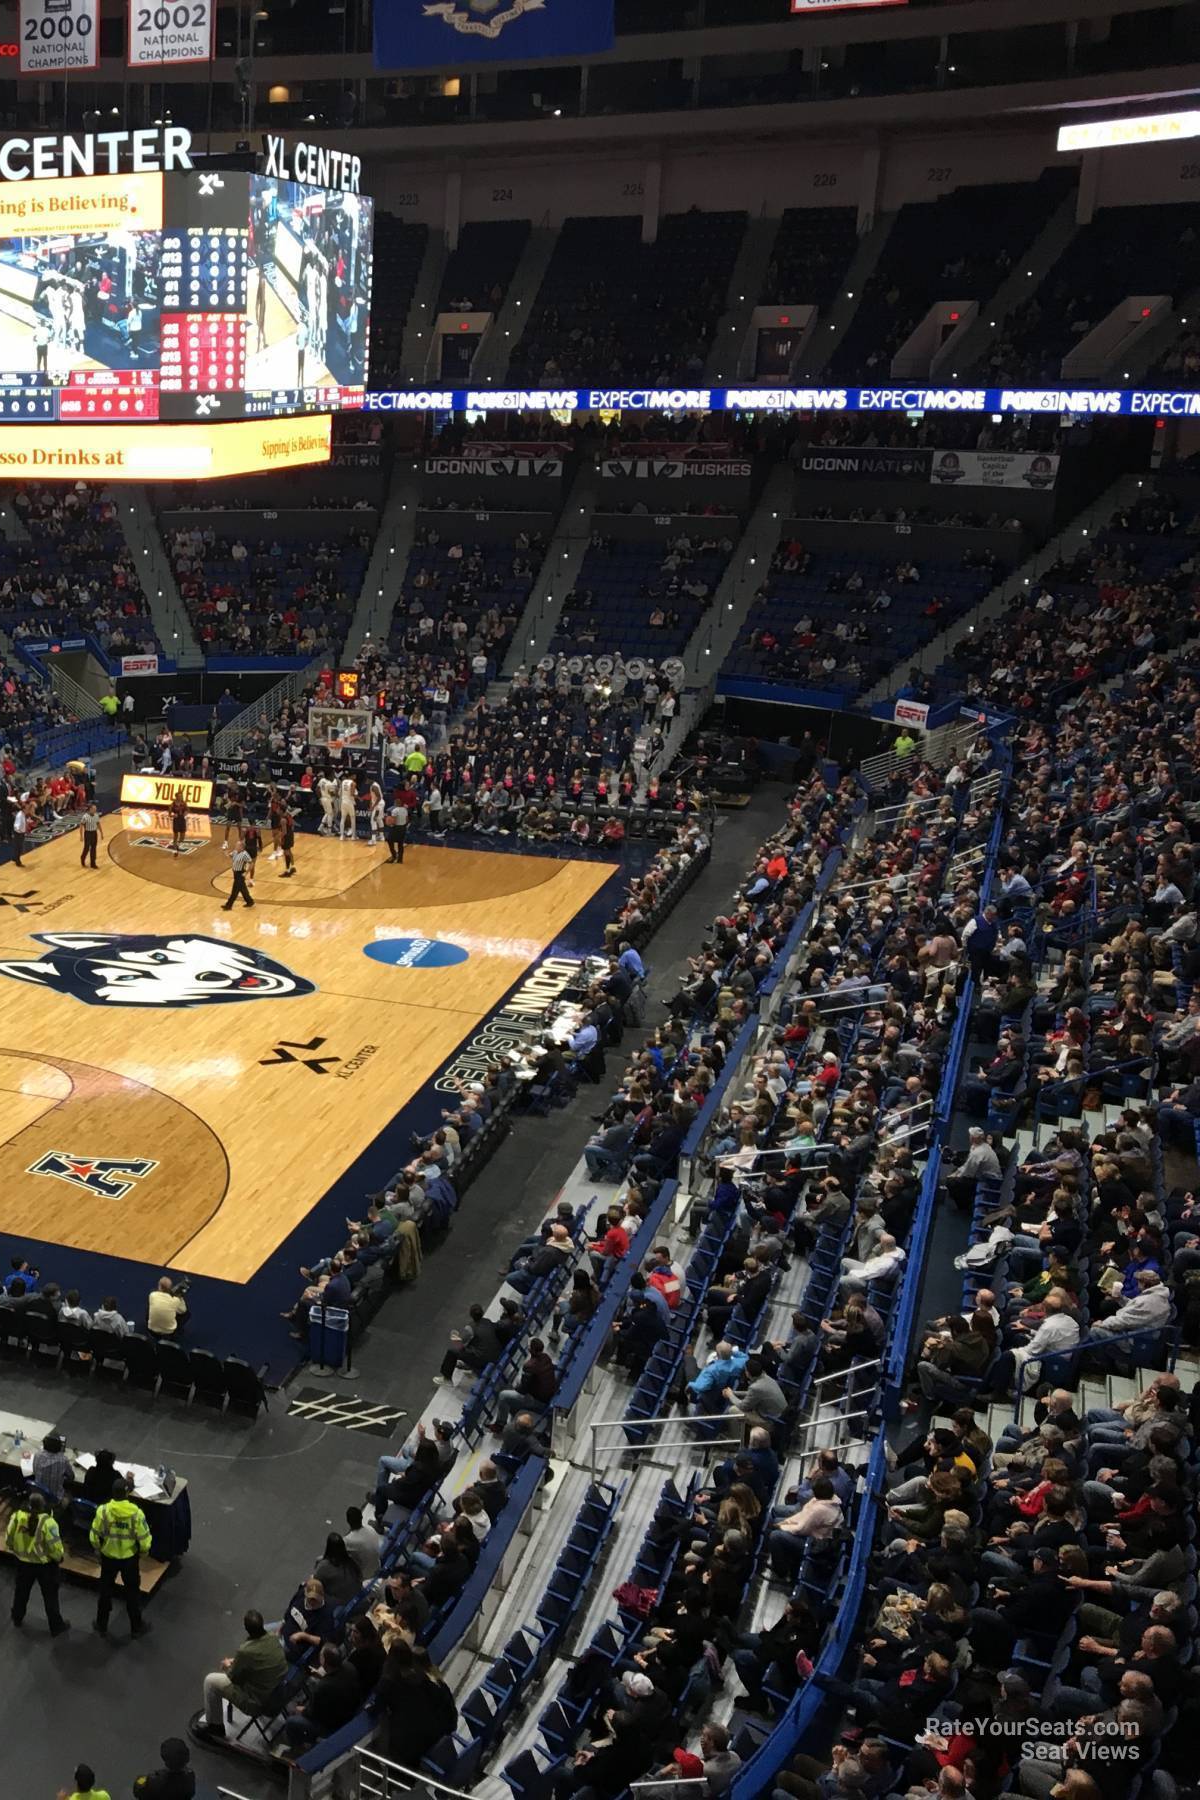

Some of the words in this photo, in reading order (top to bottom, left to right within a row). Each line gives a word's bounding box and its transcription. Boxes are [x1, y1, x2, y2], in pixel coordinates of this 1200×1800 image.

[137, 4, 206, 32] 2002
[24, 14, 92, 41] 2000
[32, 41, 85, 55] NATIONAL
[143, 33, 200, 46] NATIONAL
[27, 55, 89, 69] CHAMPIONS
[138, 46, 204, 61] CHAMPIONS
[265, 134, 290, 180] XL
[294, 141, 362, 194] CENTER
[31, 200, 45, 214] is
[48, 193, 129, 214] Believing
[492, 188, 513, 202] 224
[262, 436, 290, 459] Sipping
[298, 433, 330, 453] Believing
[32, 447, 101, 466] Drinks
[104, 450, 124, 466] at
[801, 456, 859, 472] UCONN
[425, 460, 486, 476] UCONN
[684, 462, 752, 477] HUSKIES
[123, 660, 157, 672] ESPN
[155, 782, 202, 804] YOLKED
[509, 957, 582, 1014] UCONN
[350, 1044, 380, 1074] CENTER
